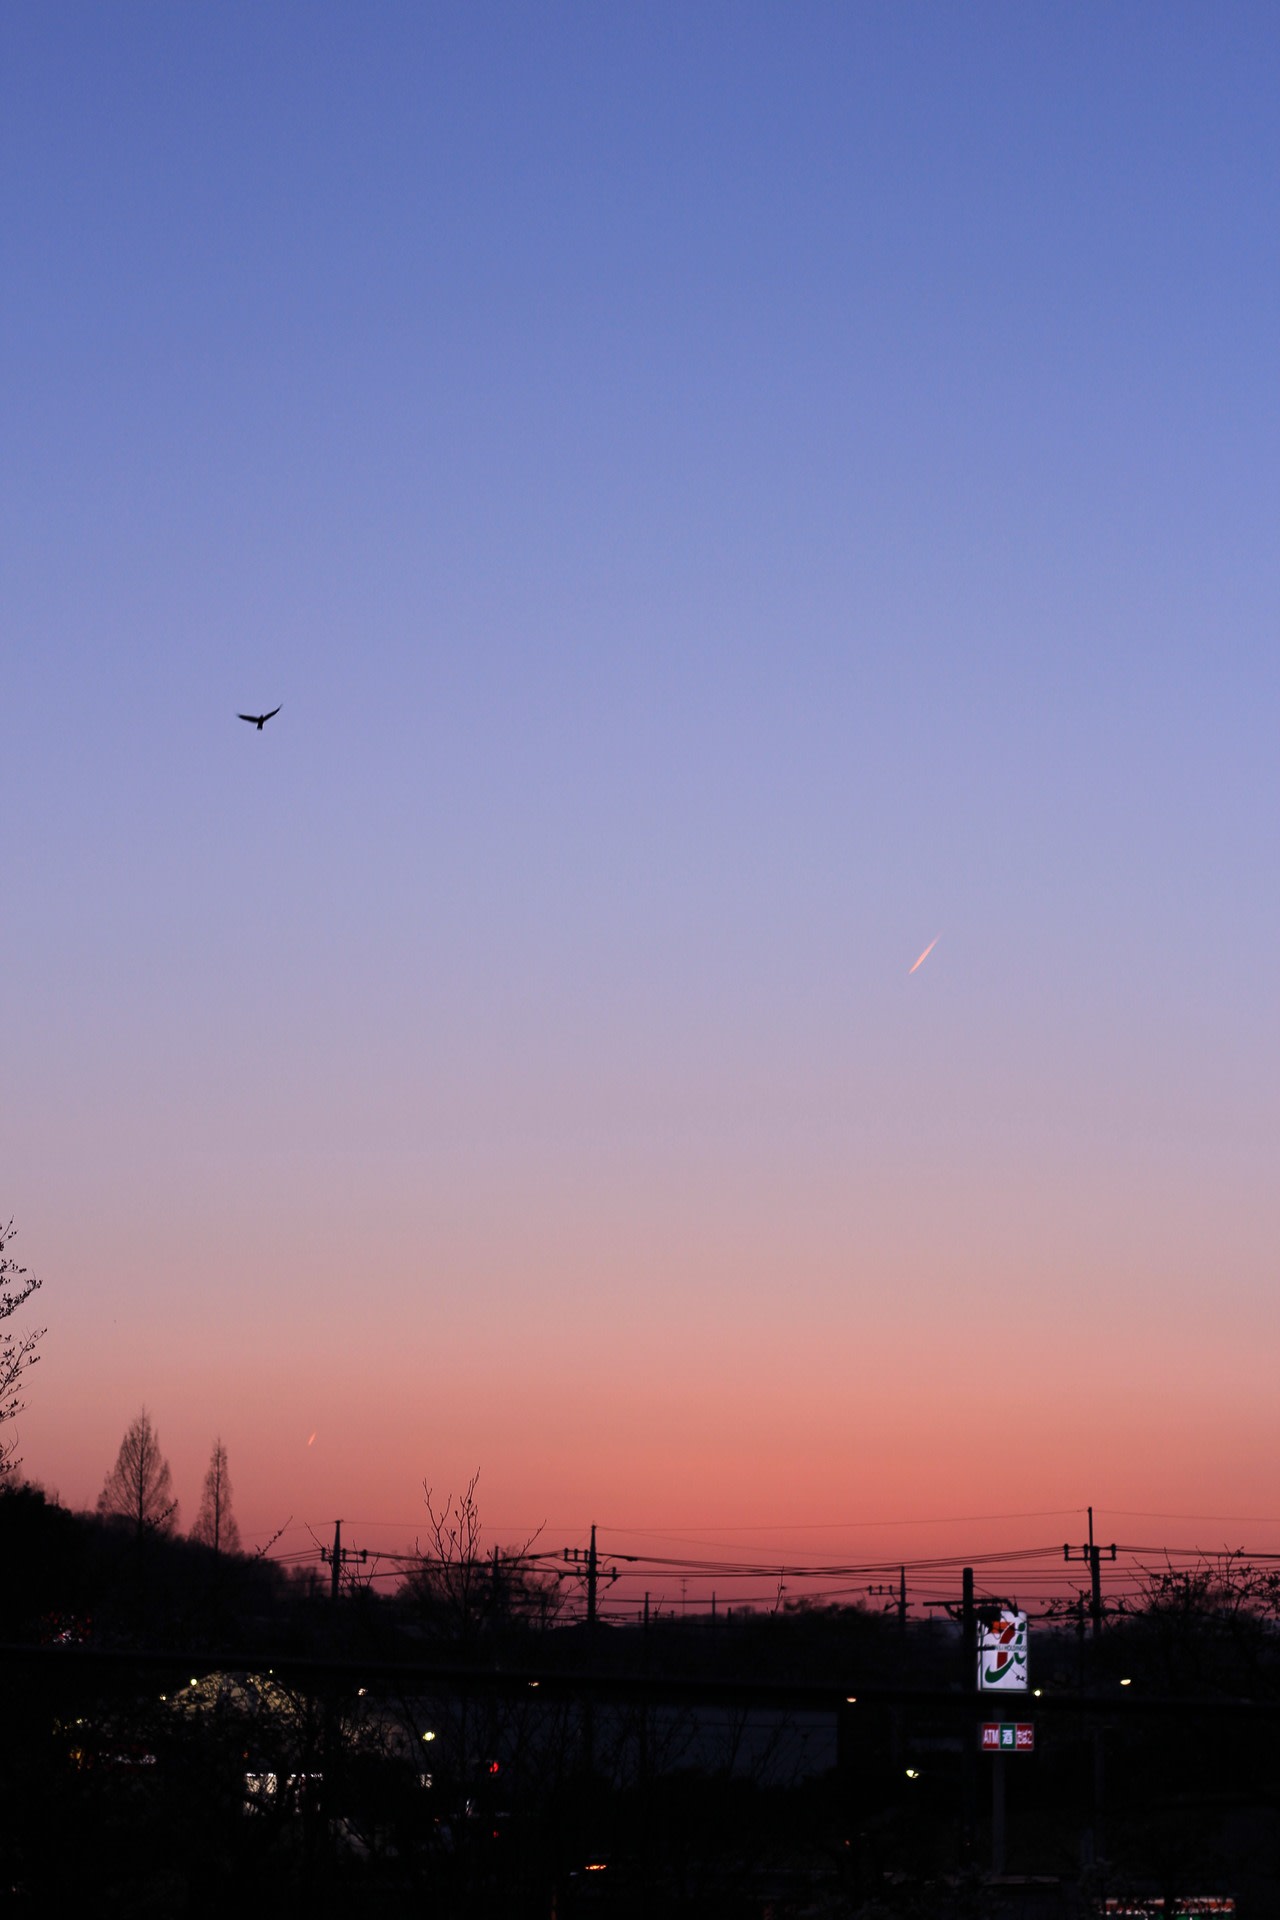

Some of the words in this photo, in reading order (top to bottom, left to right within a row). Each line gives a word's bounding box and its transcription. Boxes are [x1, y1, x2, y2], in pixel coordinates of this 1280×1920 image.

[983, 1729, 999, 1744] ATM
[1002, 1729, 1014, 1744] 酒
[1016, 1729, 1033, 1744] たばこ
